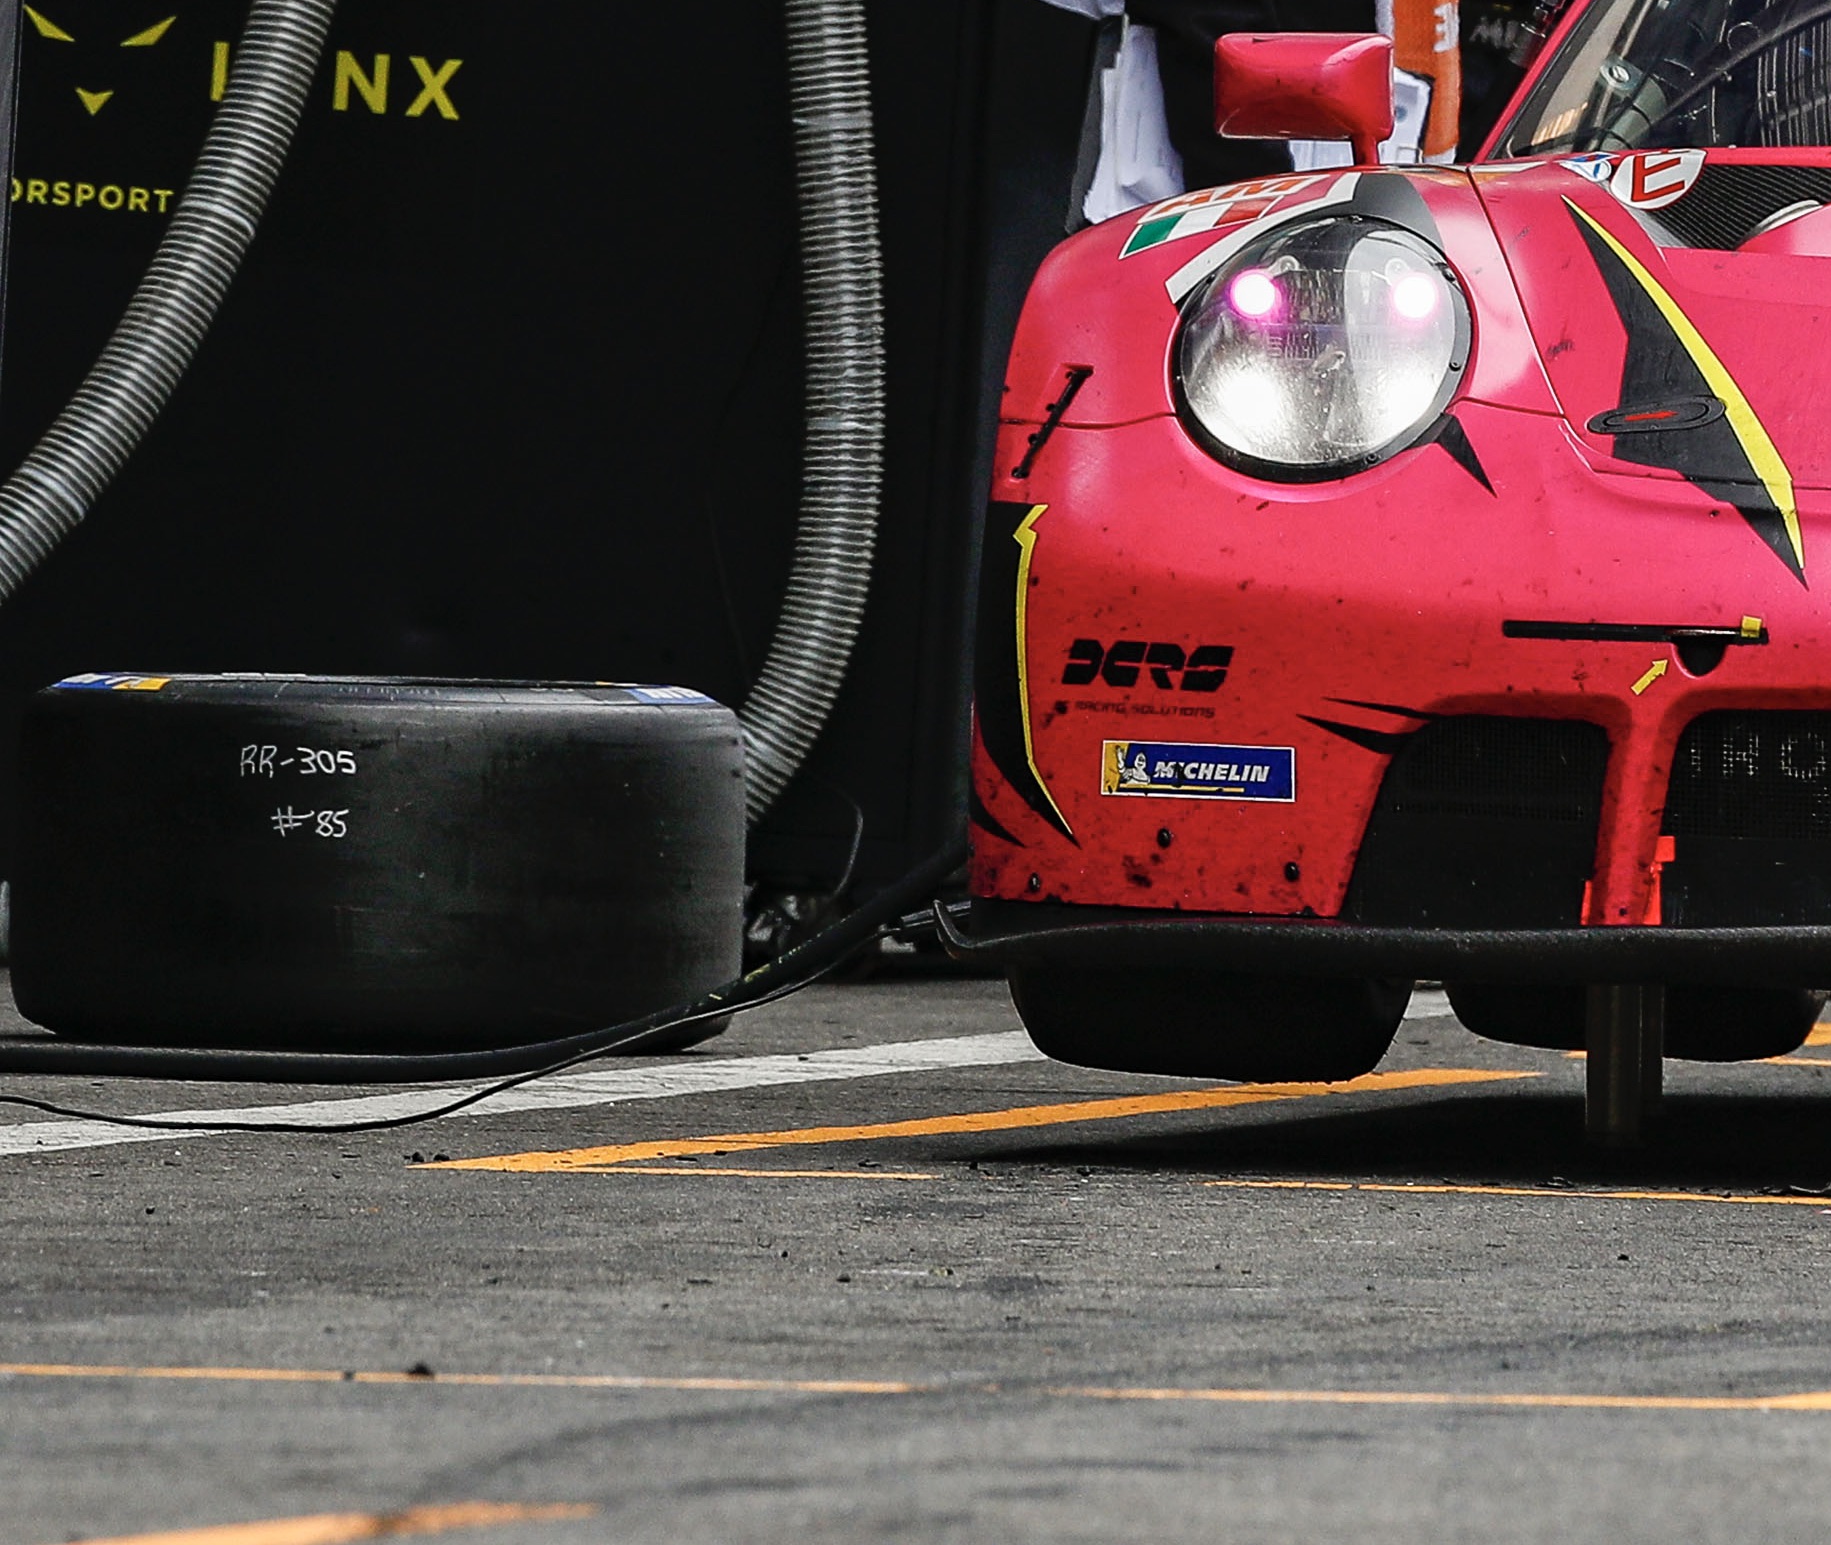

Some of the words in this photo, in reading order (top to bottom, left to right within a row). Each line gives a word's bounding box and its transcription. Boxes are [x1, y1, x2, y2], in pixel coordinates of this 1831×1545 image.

[211, 40, 463, 122] LNX
[10, 178, 174, 214] ORSPORT
[240, 745, 358, 779] RR-305
[270, 807, 350, 840] #85
